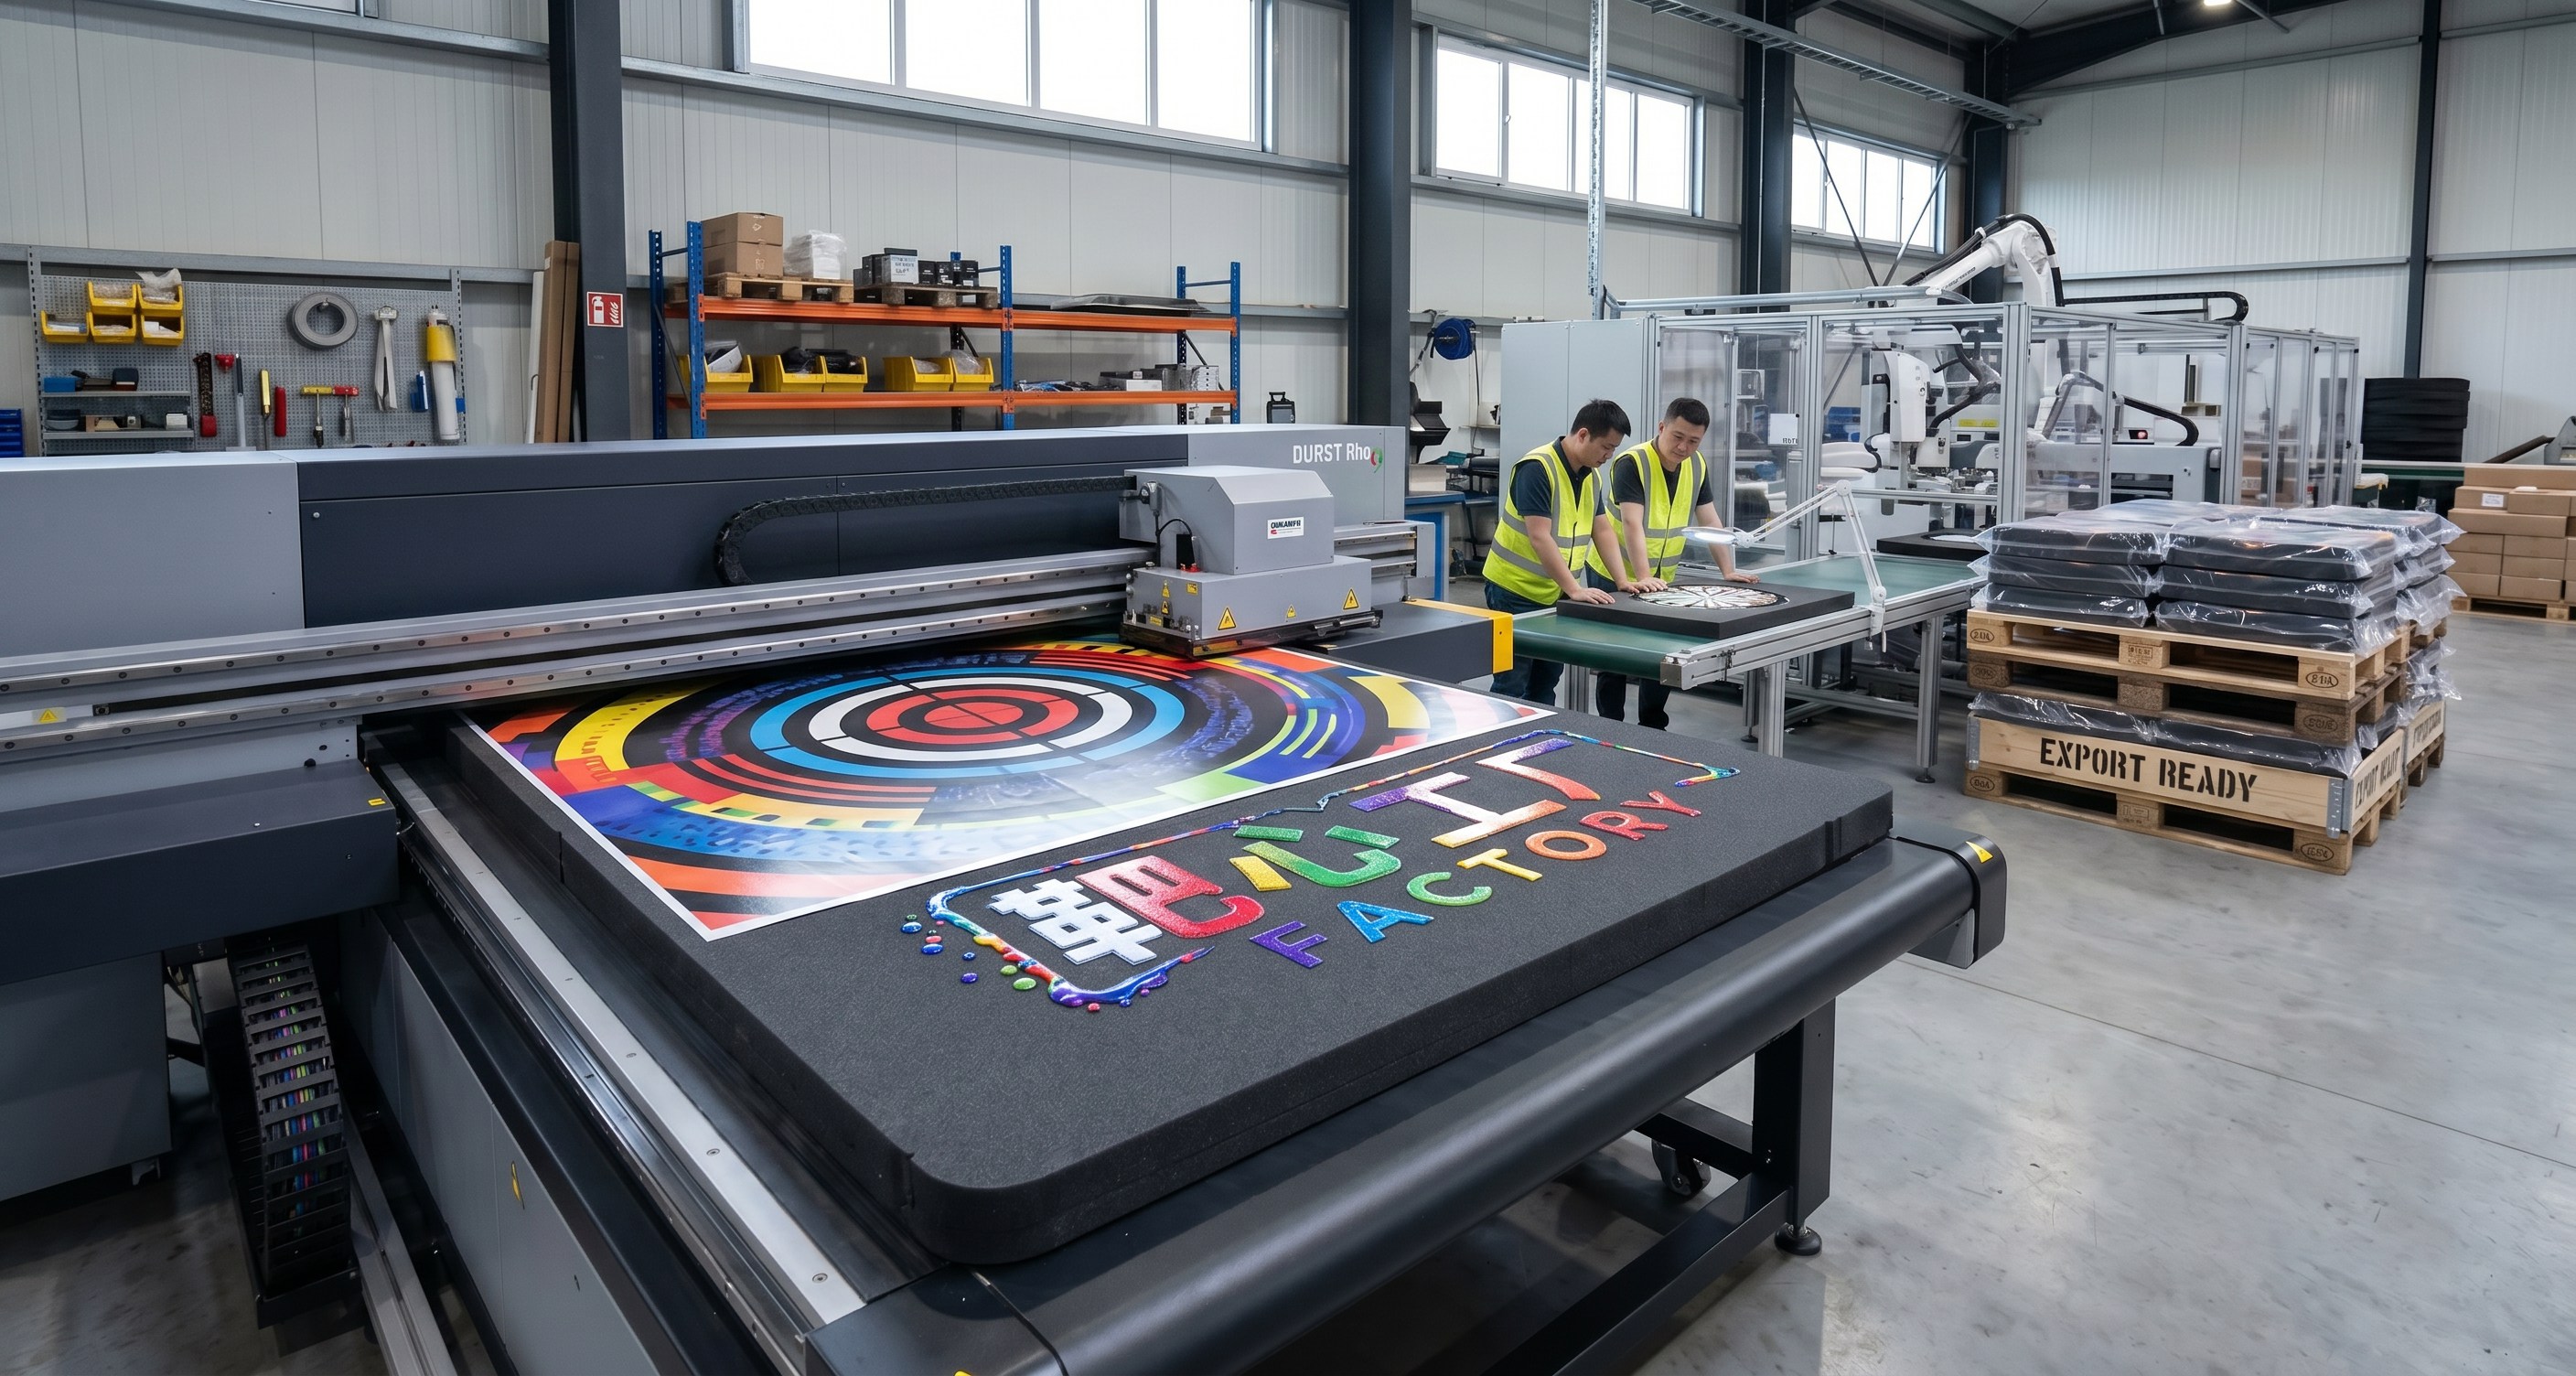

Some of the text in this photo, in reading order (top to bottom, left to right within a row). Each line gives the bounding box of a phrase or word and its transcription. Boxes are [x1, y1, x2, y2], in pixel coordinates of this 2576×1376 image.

[1293, 443, 1343, 464] DURST
[2040, 736, 2258, 802] EXPORT READY
[1248, 790, 1702, 970] FACTORY
